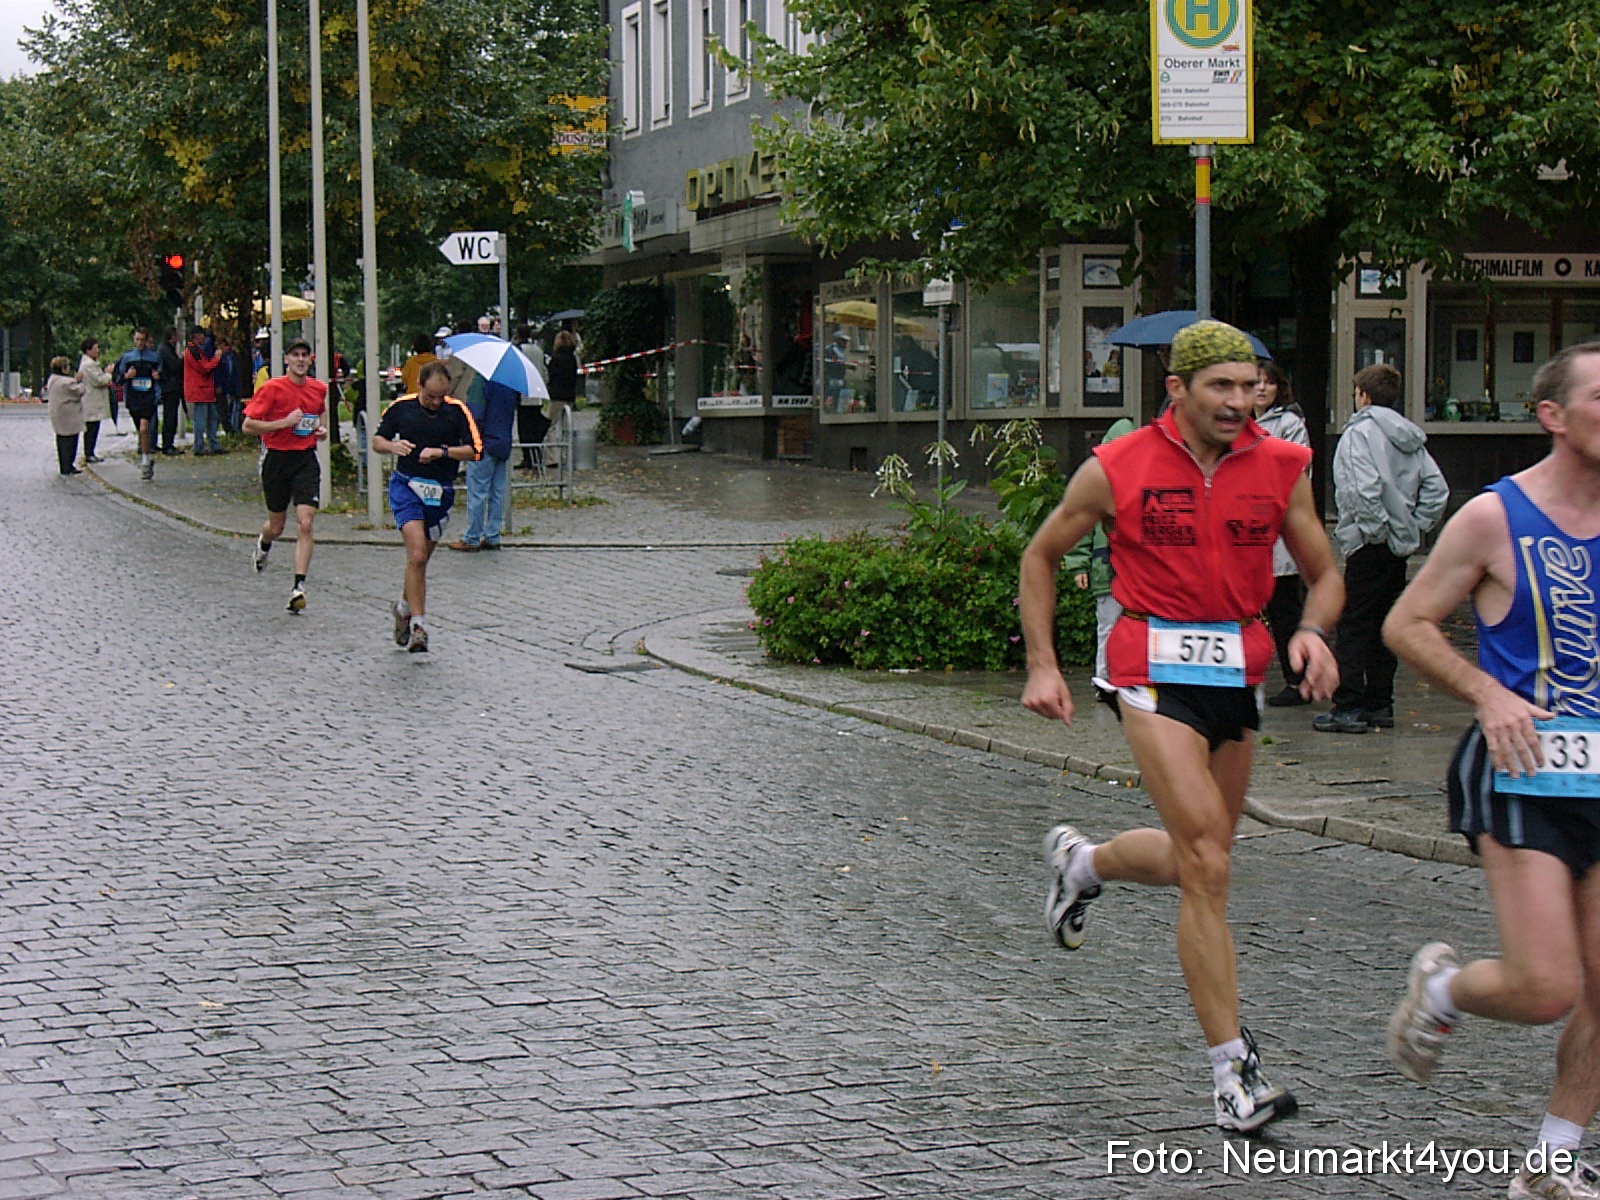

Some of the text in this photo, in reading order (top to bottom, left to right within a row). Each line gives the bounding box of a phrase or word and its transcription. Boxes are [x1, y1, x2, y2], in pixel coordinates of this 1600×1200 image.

[1163, 58, 1241, 69] Oberer Markt
[457, 236, 491, 260] WC
[1179, 634, 1227, 664] 575
[1537, 734, 1589, 769] 33
